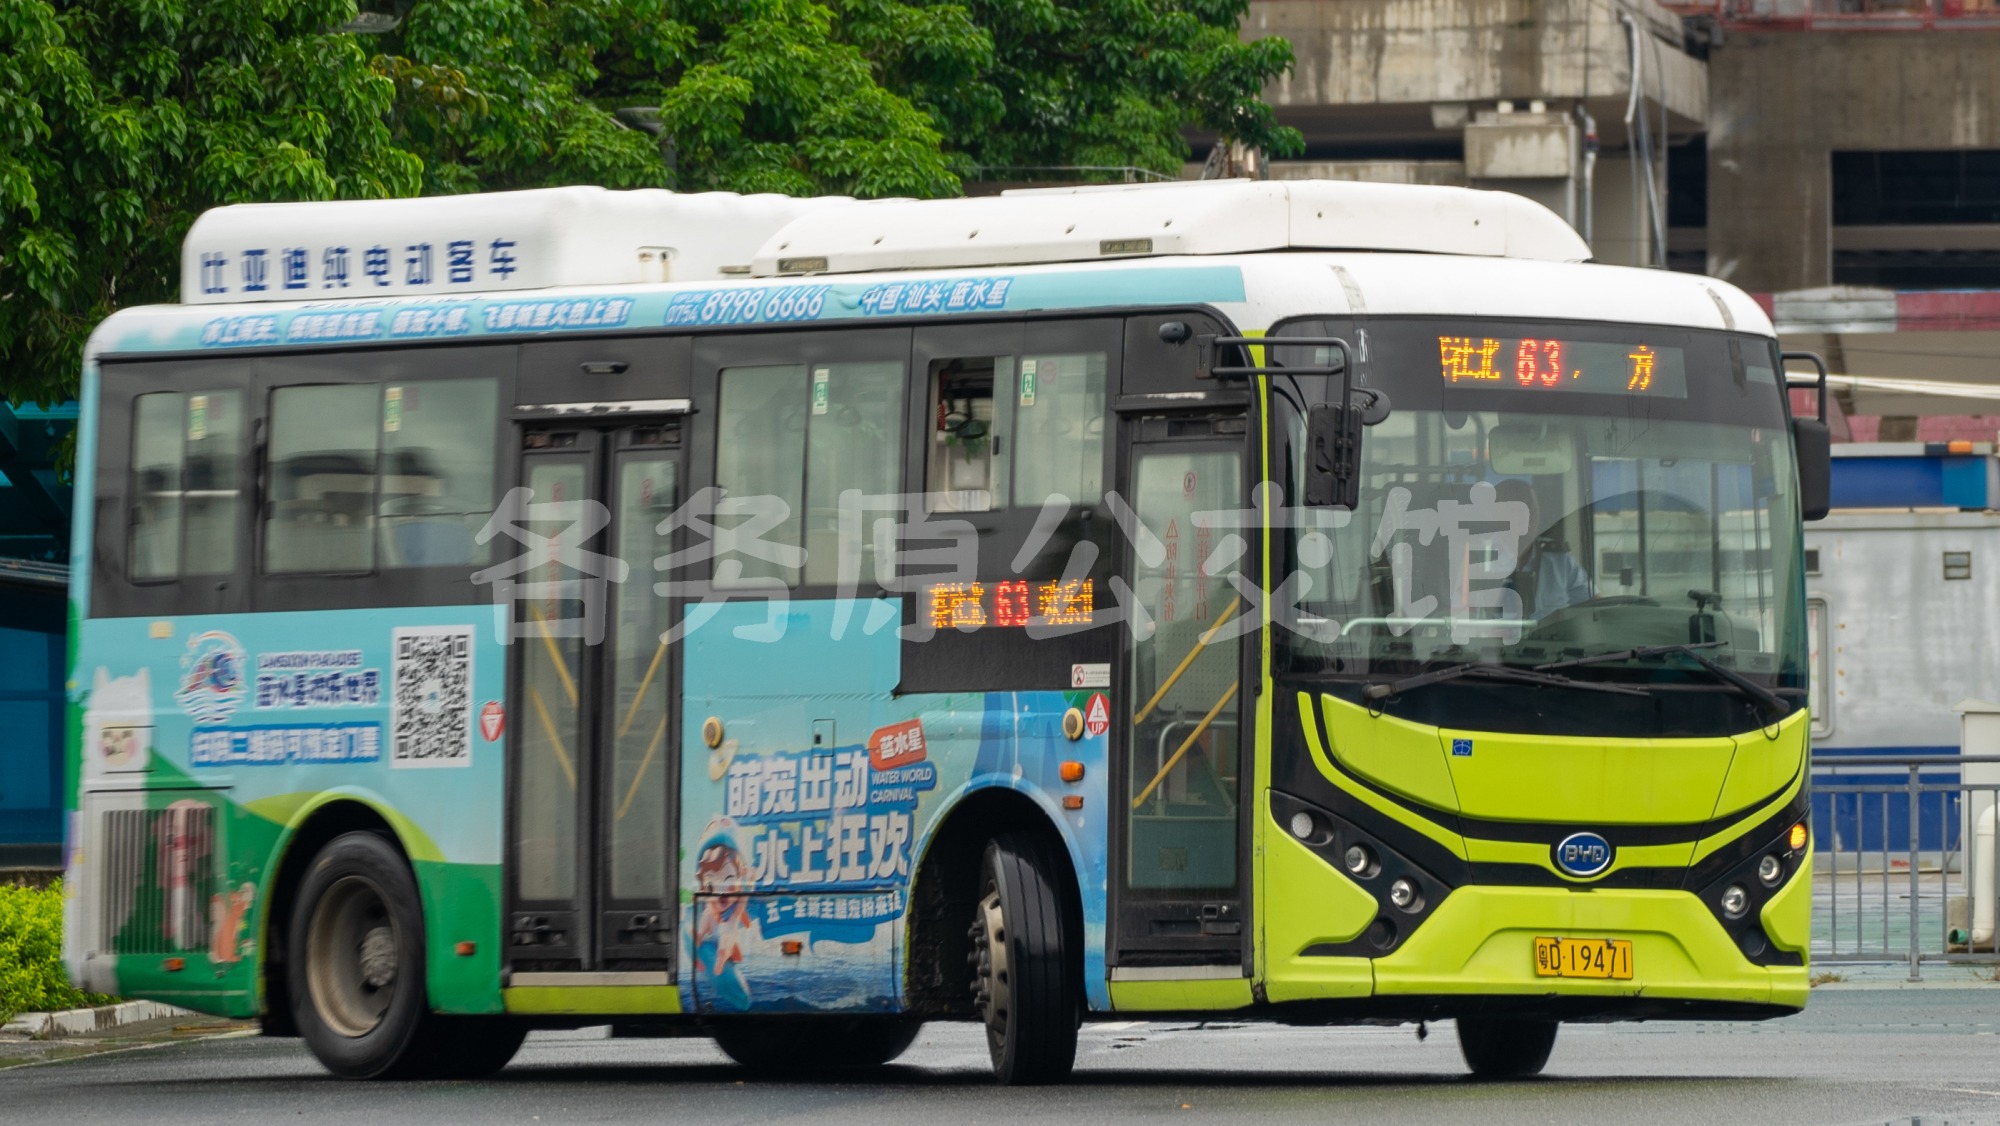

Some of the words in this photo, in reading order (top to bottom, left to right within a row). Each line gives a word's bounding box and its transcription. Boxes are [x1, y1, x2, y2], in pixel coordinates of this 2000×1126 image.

[201, 239, 517, 294] 比亚迪纯电动客车
[666, 303, 699, 323] 0754
[700, 290, 766, 322] 8998
[765, 287, 828, 319] 6666
[1518, 339, 1560, 386] 63
[1627, 345, 1654, 390] 方
[997, 580, 1029, 626] 63
[1093, 704, 1103, 717] 上
[879, 727, 923, 760] 蓝水星
[1091, 723, 1104, 735] UP
[728, 751, 869, 817] 萌宠出动
[872, 771, 900, 785] WATER
[901, 768, 933, 783] WORLD
[871, 788, 914, 803] CARNIVAL
[754, 811, 909, 886] 水上狂欢
[1564, 844, 1605, 863] BYD
